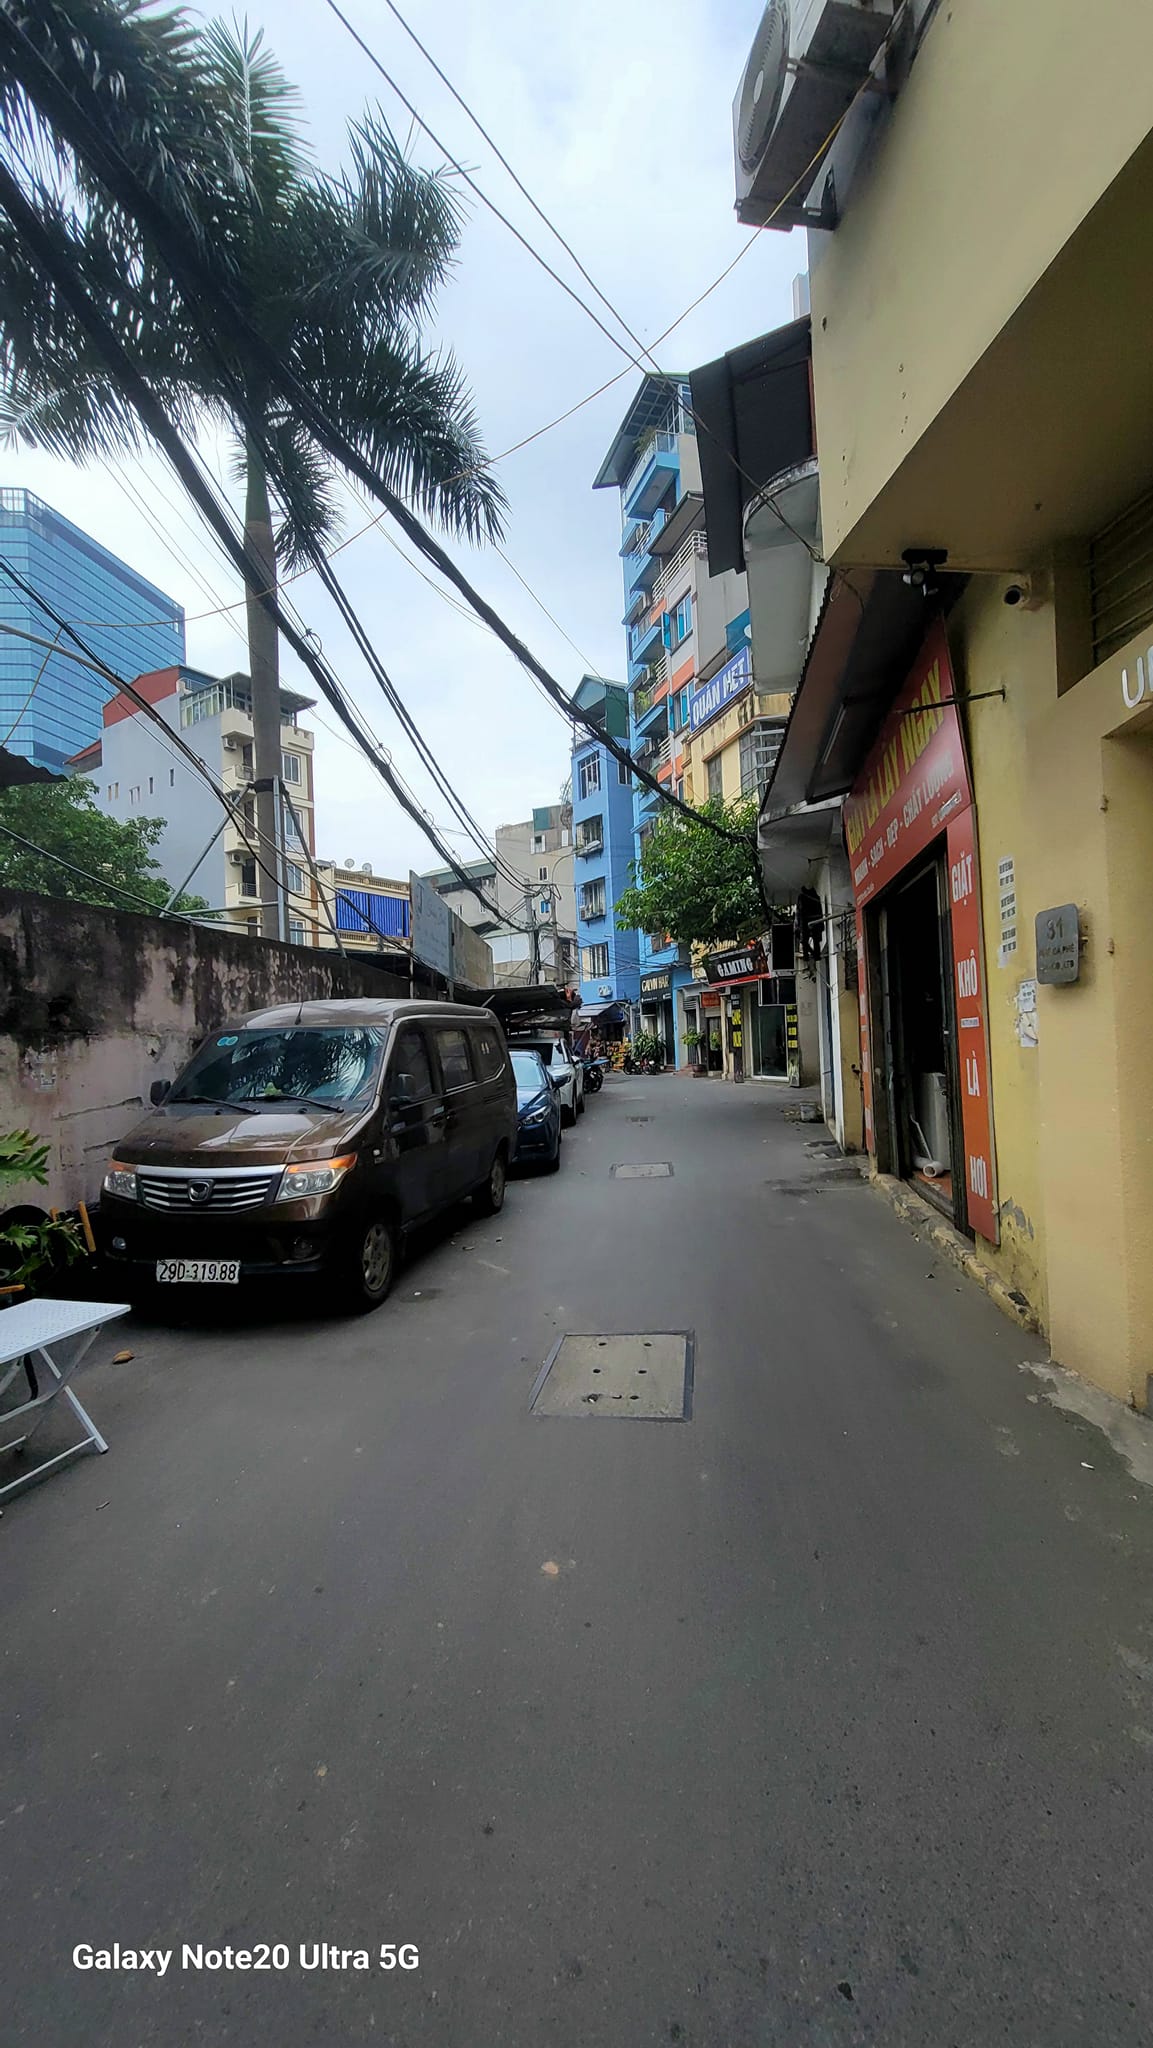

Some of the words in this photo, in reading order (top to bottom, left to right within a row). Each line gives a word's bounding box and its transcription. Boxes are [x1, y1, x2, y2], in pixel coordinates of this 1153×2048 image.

[692, 684, 720, 726] QUÁN
[899, 657, 944, 775] NGAY
[952, 850, 973, 906] GIẶT
[717, 957, 754, 977] GAMING
[957, 949, 978, 998] KHÔ
[966, 1050, 980, 1097] LÀ
[969, 1155, 988, 1199] HƠI
[159, 1262, 237, 1281] 29D-319.88
